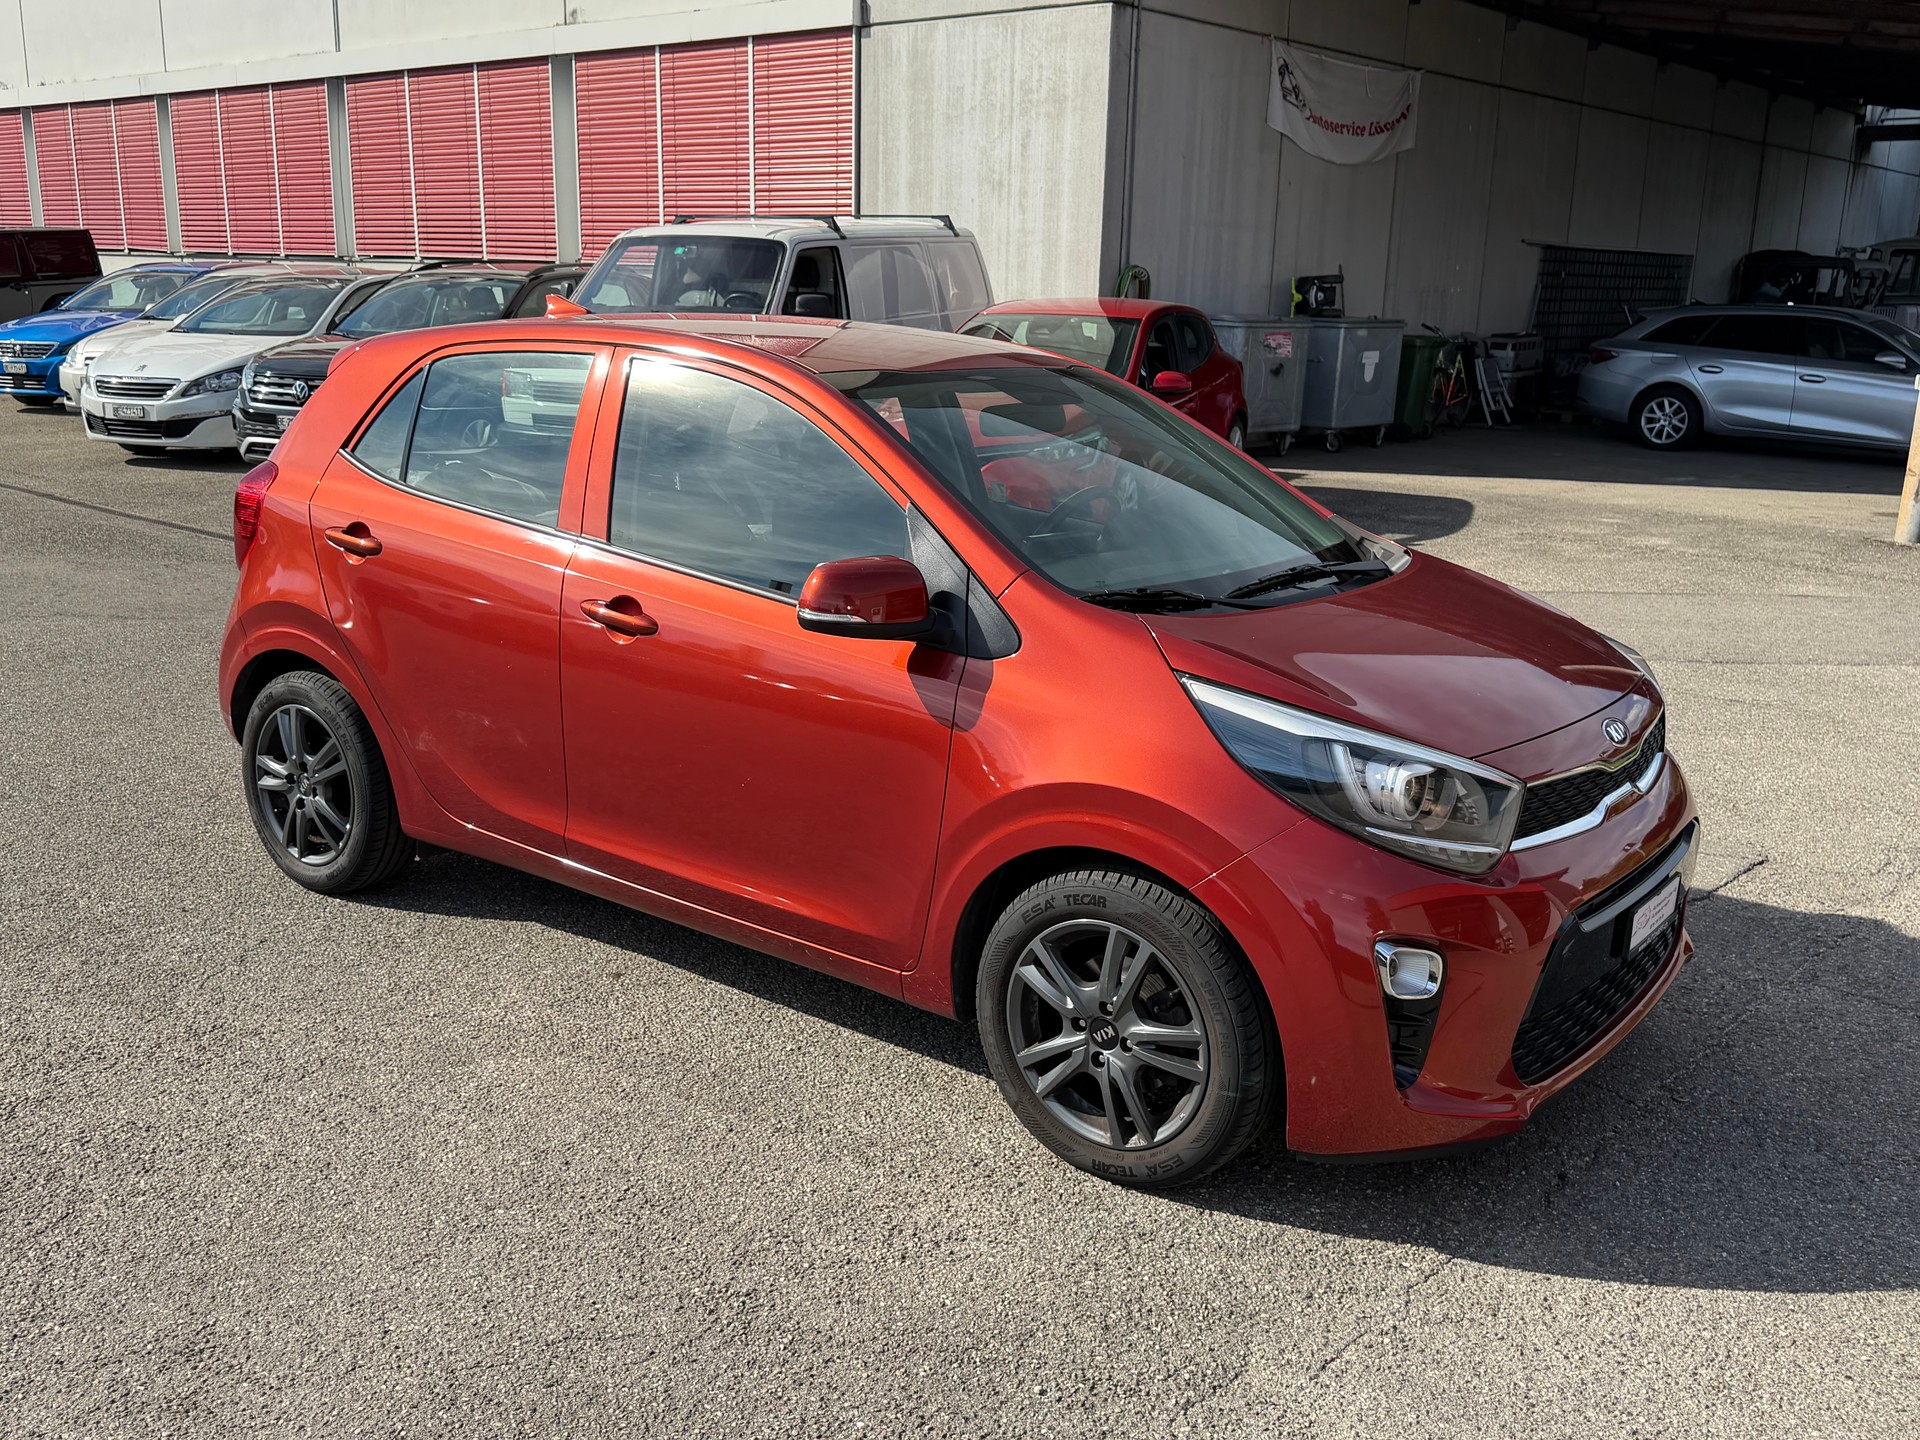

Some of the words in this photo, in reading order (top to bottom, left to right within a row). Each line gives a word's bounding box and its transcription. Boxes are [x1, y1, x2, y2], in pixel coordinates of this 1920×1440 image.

[340, 733, 351, 751] PRO
[1063, 894, 1107, 908] TECAR
[1092, 1025, 1116, 1043] KIA
[1091, 1158, 1138, 1178] TECAR
